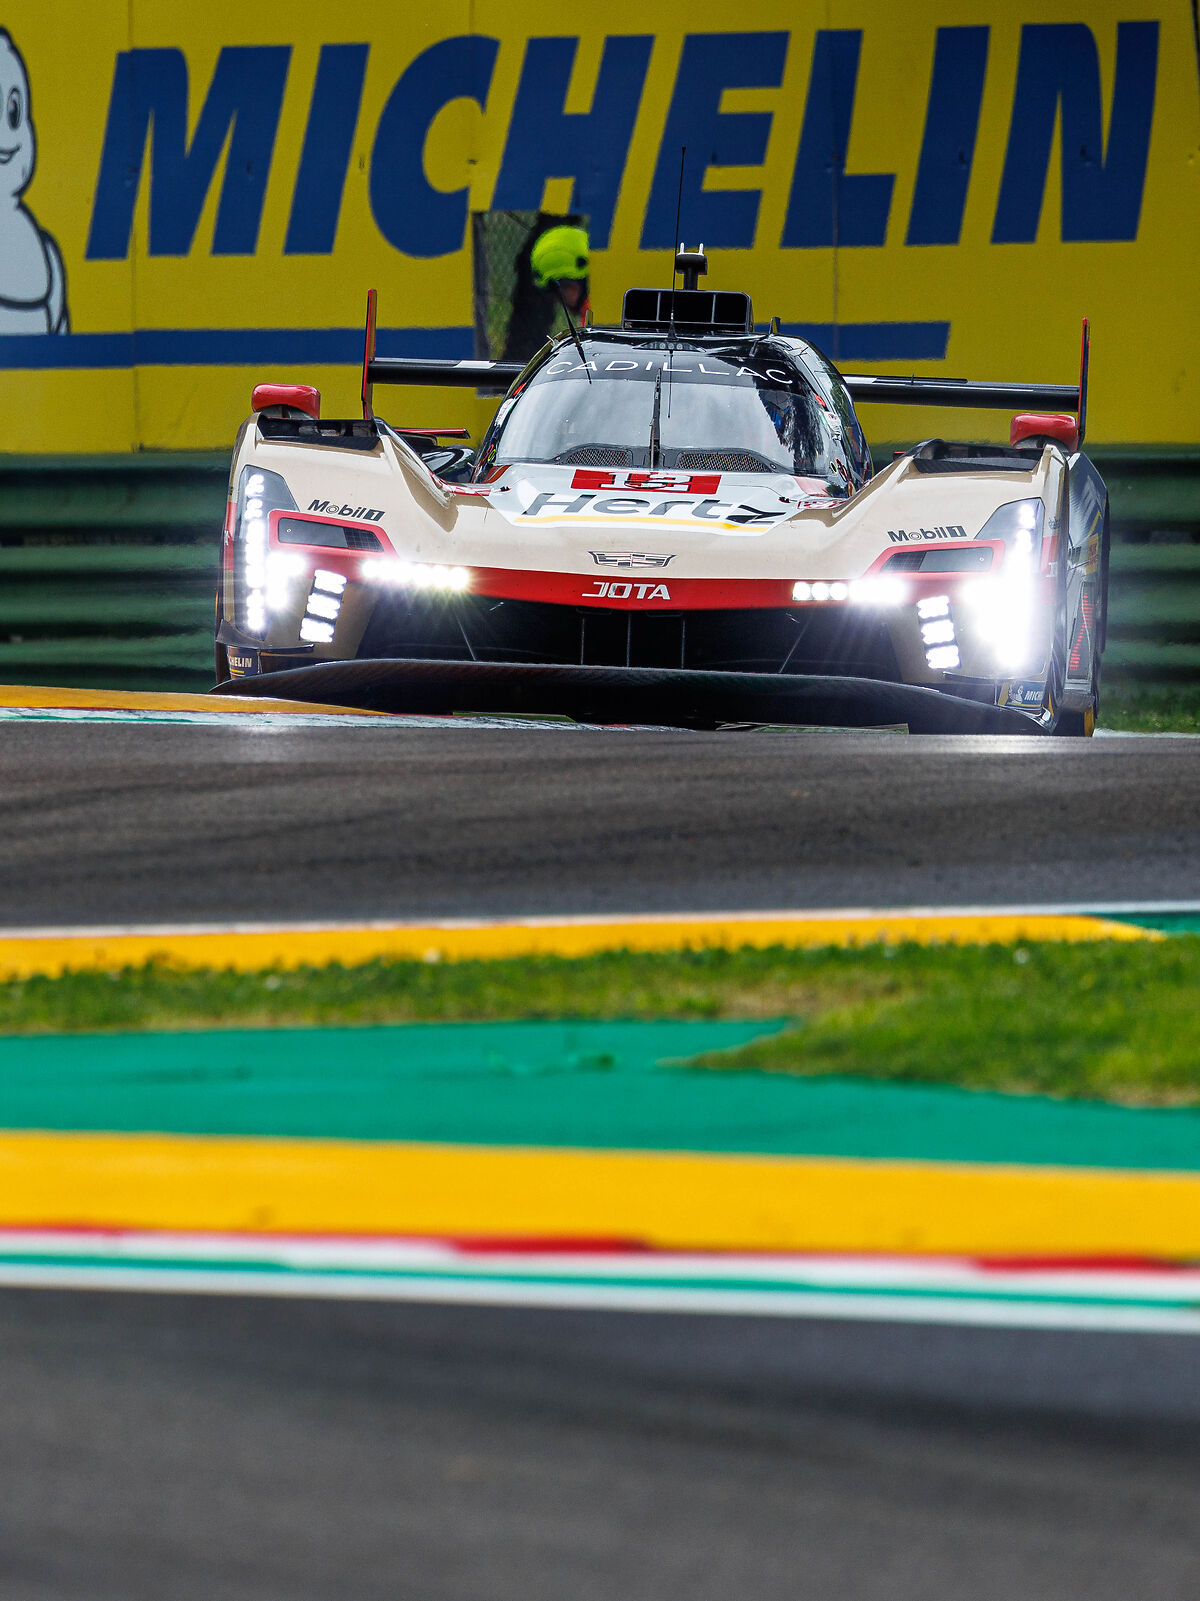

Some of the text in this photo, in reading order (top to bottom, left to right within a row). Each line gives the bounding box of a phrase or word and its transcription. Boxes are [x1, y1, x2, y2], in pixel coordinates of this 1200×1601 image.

[85, 20, 1161, 259] MICHELIN
[546, 360, 793, 384] CADILLAC
[521, 492, 786, 525] Hertz
[581, 581, 671, 600] JOTA
